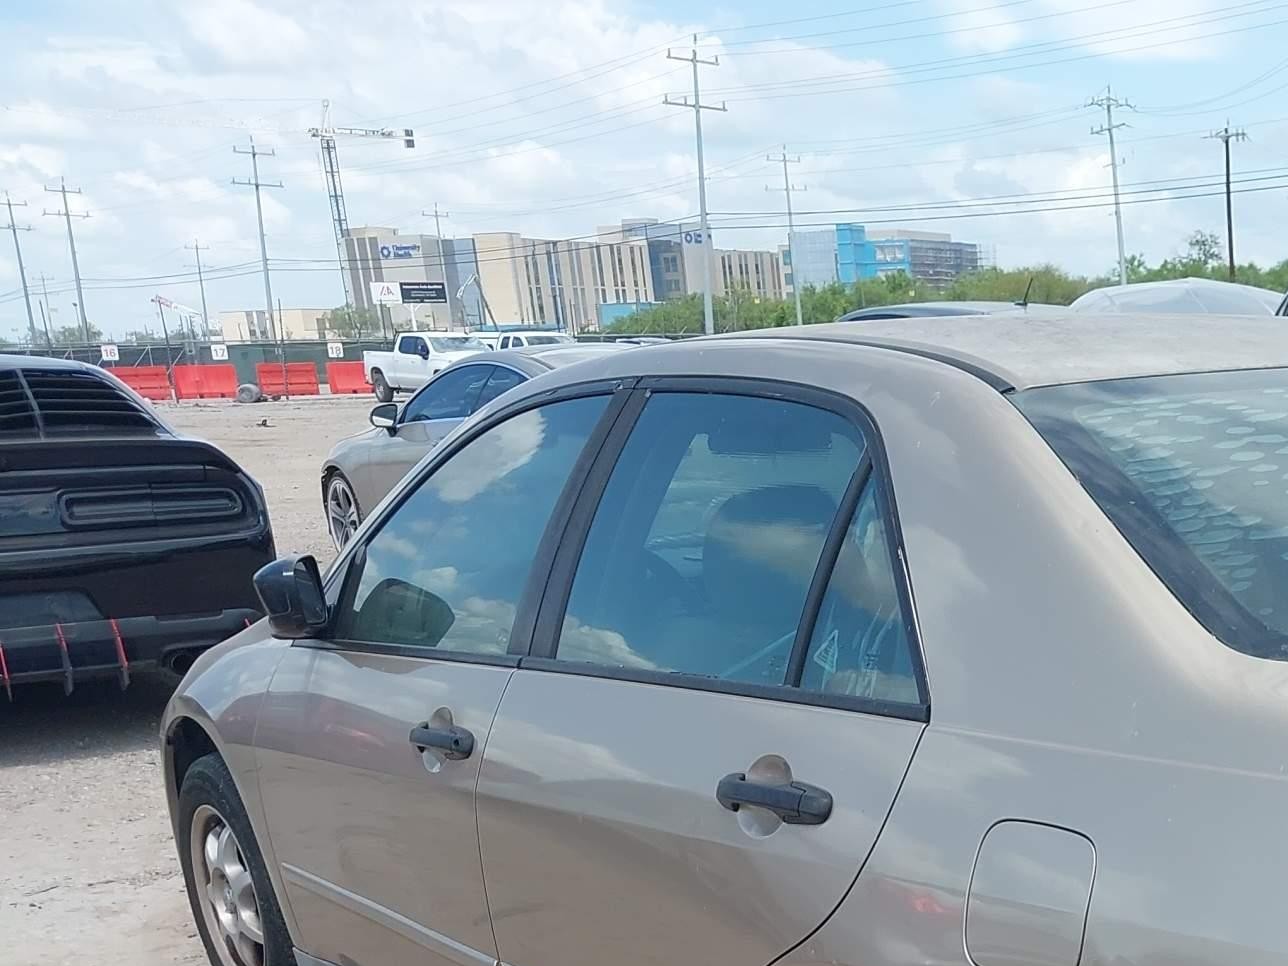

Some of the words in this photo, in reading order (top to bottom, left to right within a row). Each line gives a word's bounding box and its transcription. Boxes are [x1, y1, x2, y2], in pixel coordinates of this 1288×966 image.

[104, 348, 116, 358] 16
[214, 348, 225, 358] 17
[329, 346, 341, 356] 18
